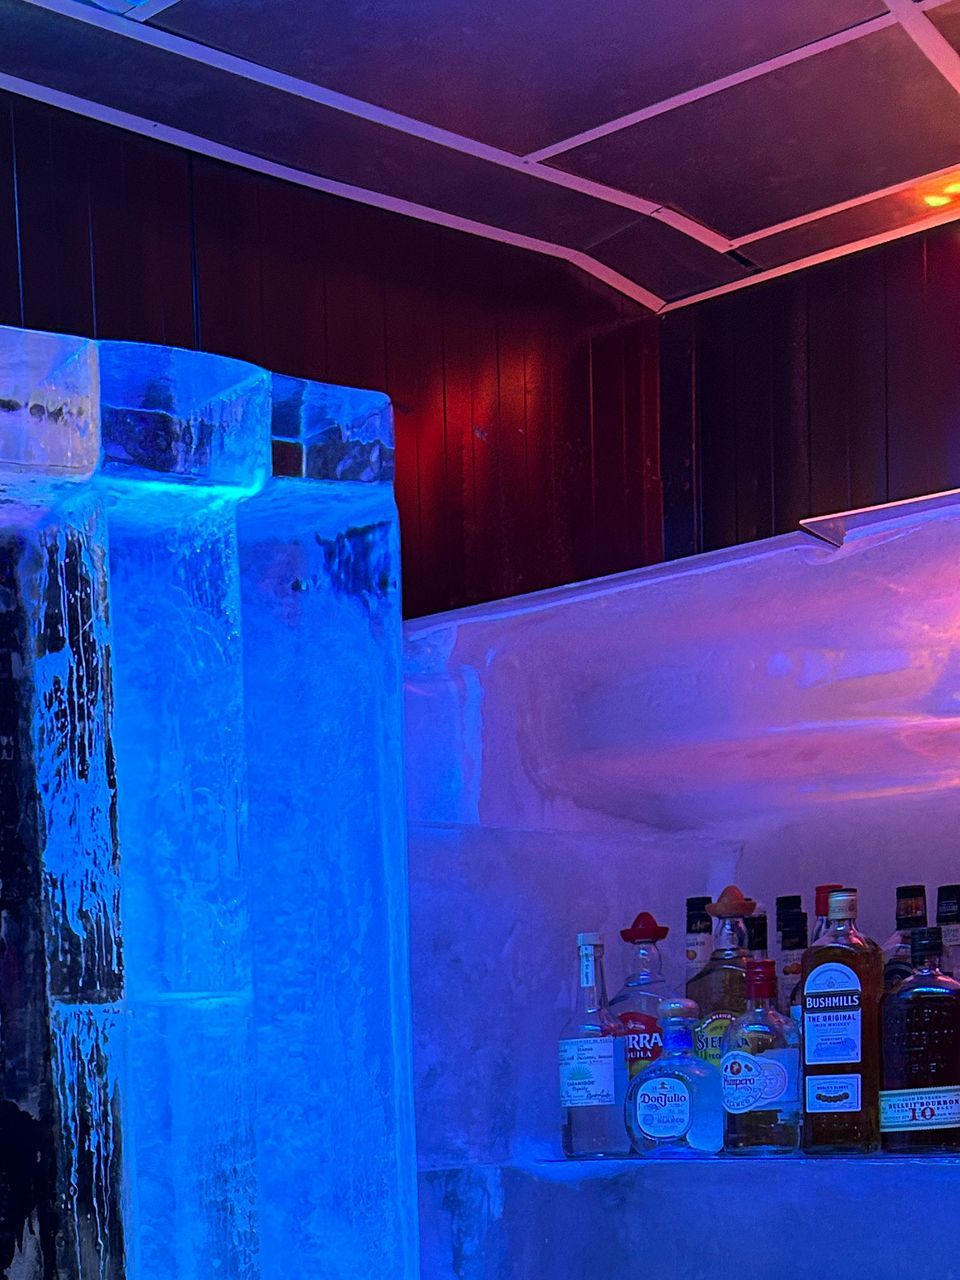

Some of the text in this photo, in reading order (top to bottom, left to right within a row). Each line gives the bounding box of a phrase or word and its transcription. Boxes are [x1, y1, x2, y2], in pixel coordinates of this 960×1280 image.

[806, 995, 859, 1008] BUSHMILLS
[822, 1013, 856, 1022] ORIGINAL
[920, 1098, 959, 1107] BOURBON
[909, 1106, 936, 1120] 10
